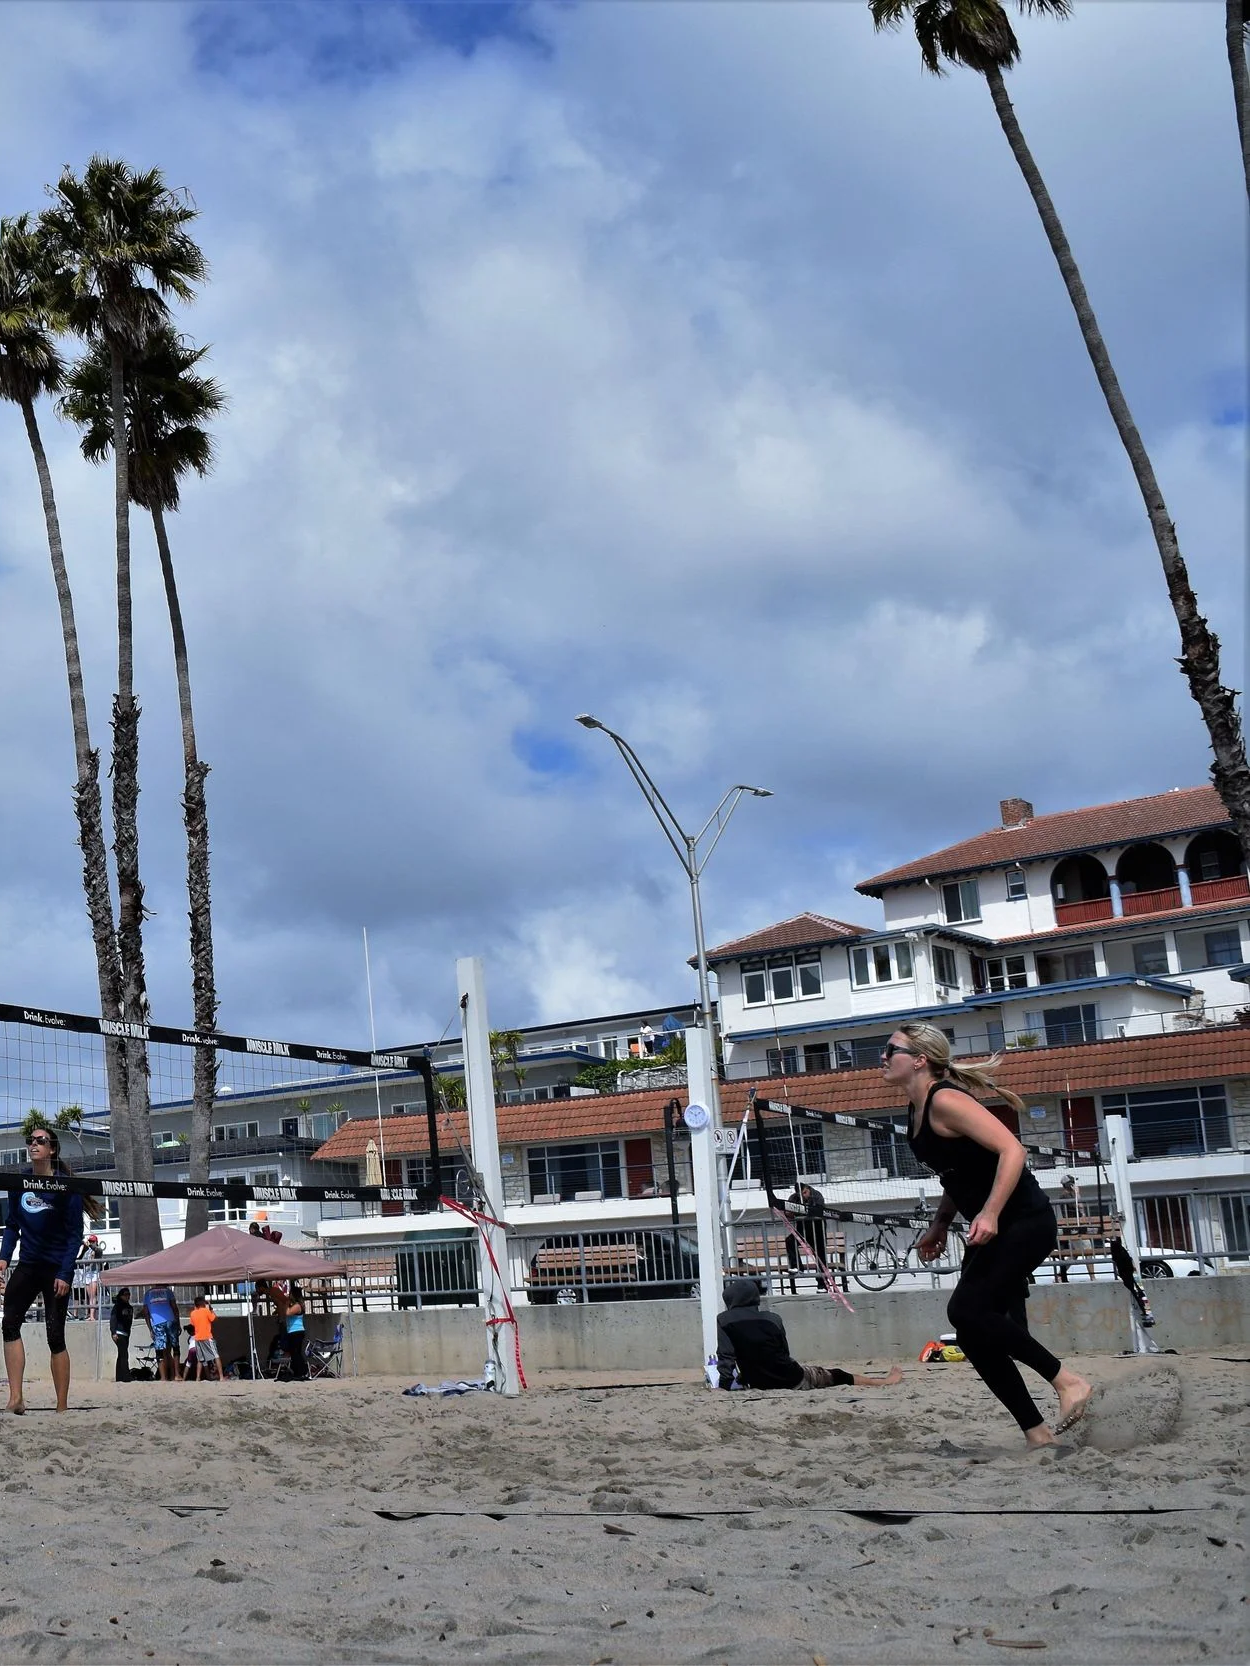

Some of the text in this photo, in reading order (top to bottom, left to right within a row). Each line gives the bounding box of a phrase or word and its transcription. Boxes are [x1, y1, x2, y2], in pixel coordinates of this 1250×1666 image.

[99, 1019, 149, 1040] MUSCLE MILK
[246, 1039, 289, 1057] MUSCLE MILK
[102, 1180, 154, 1197] MUSCLE MILK
[253, 1187, 297, 1200] MUSCLE MILK
